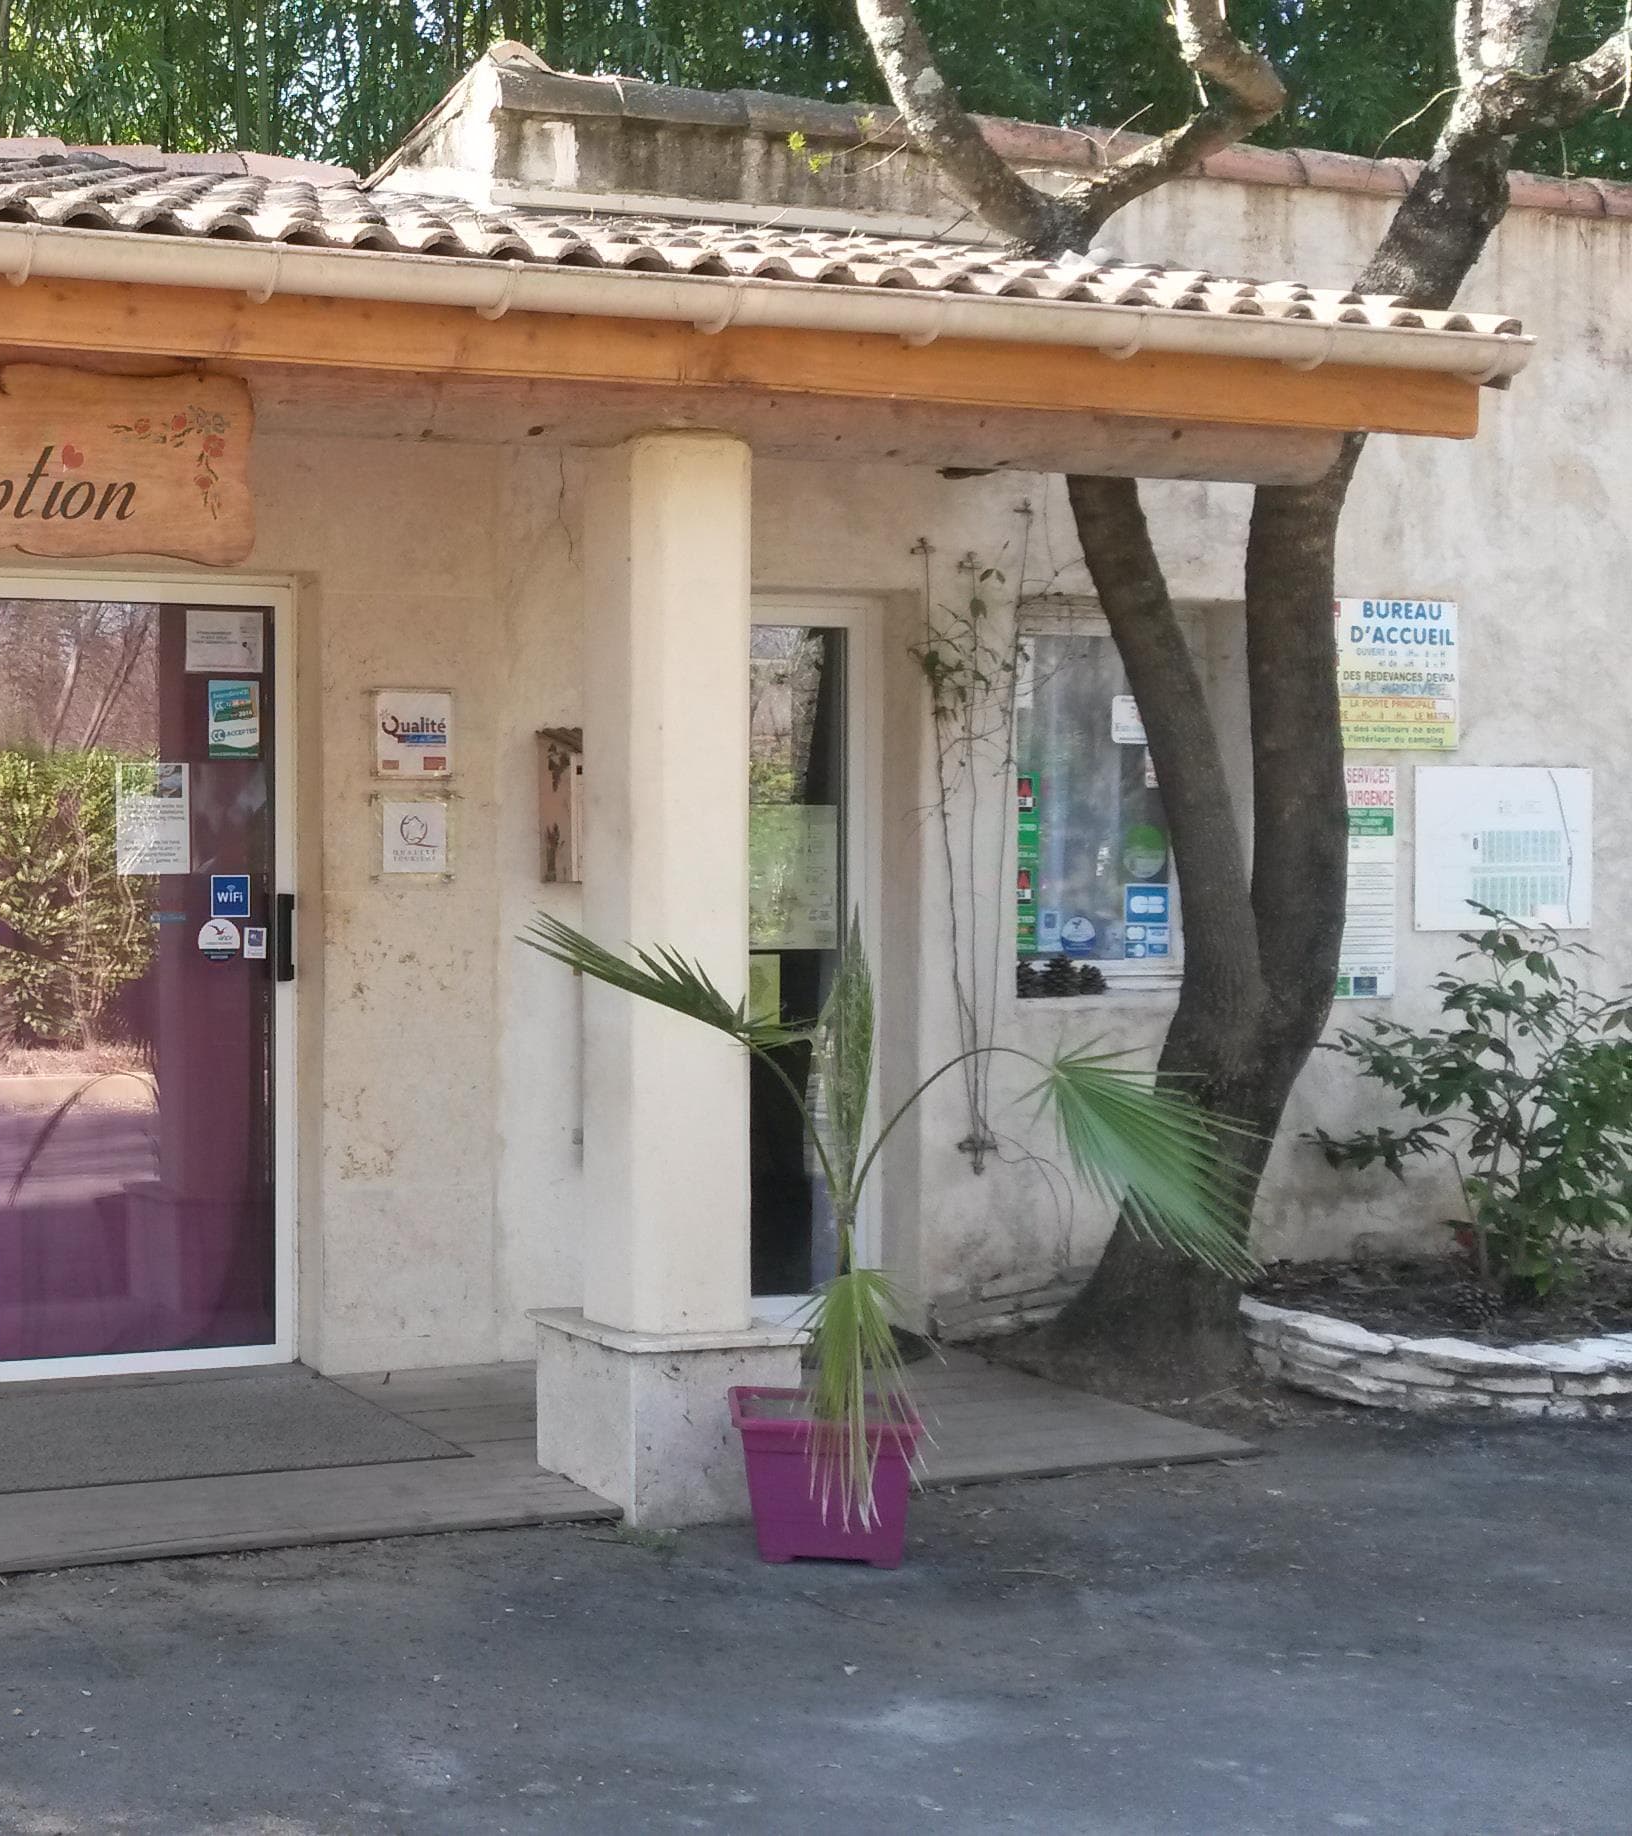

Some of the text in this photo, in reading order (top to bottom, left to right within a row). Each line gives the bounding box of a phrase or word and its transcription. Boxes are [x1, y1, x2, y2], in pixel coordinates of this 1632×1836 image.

[1362, 600, 1442, 621] BUREAU
[1350, 625, 1455, 646] D'ACCUEIL
[1343, 670, 1362, 681] DES
[1364, 671, 1424, 682] REDEVANCES
[1426, 672, 1456, 683] DEVRA
[382, 715, 447, 738] Qualité
[1346, 767, 1390, 784] SERVICES
